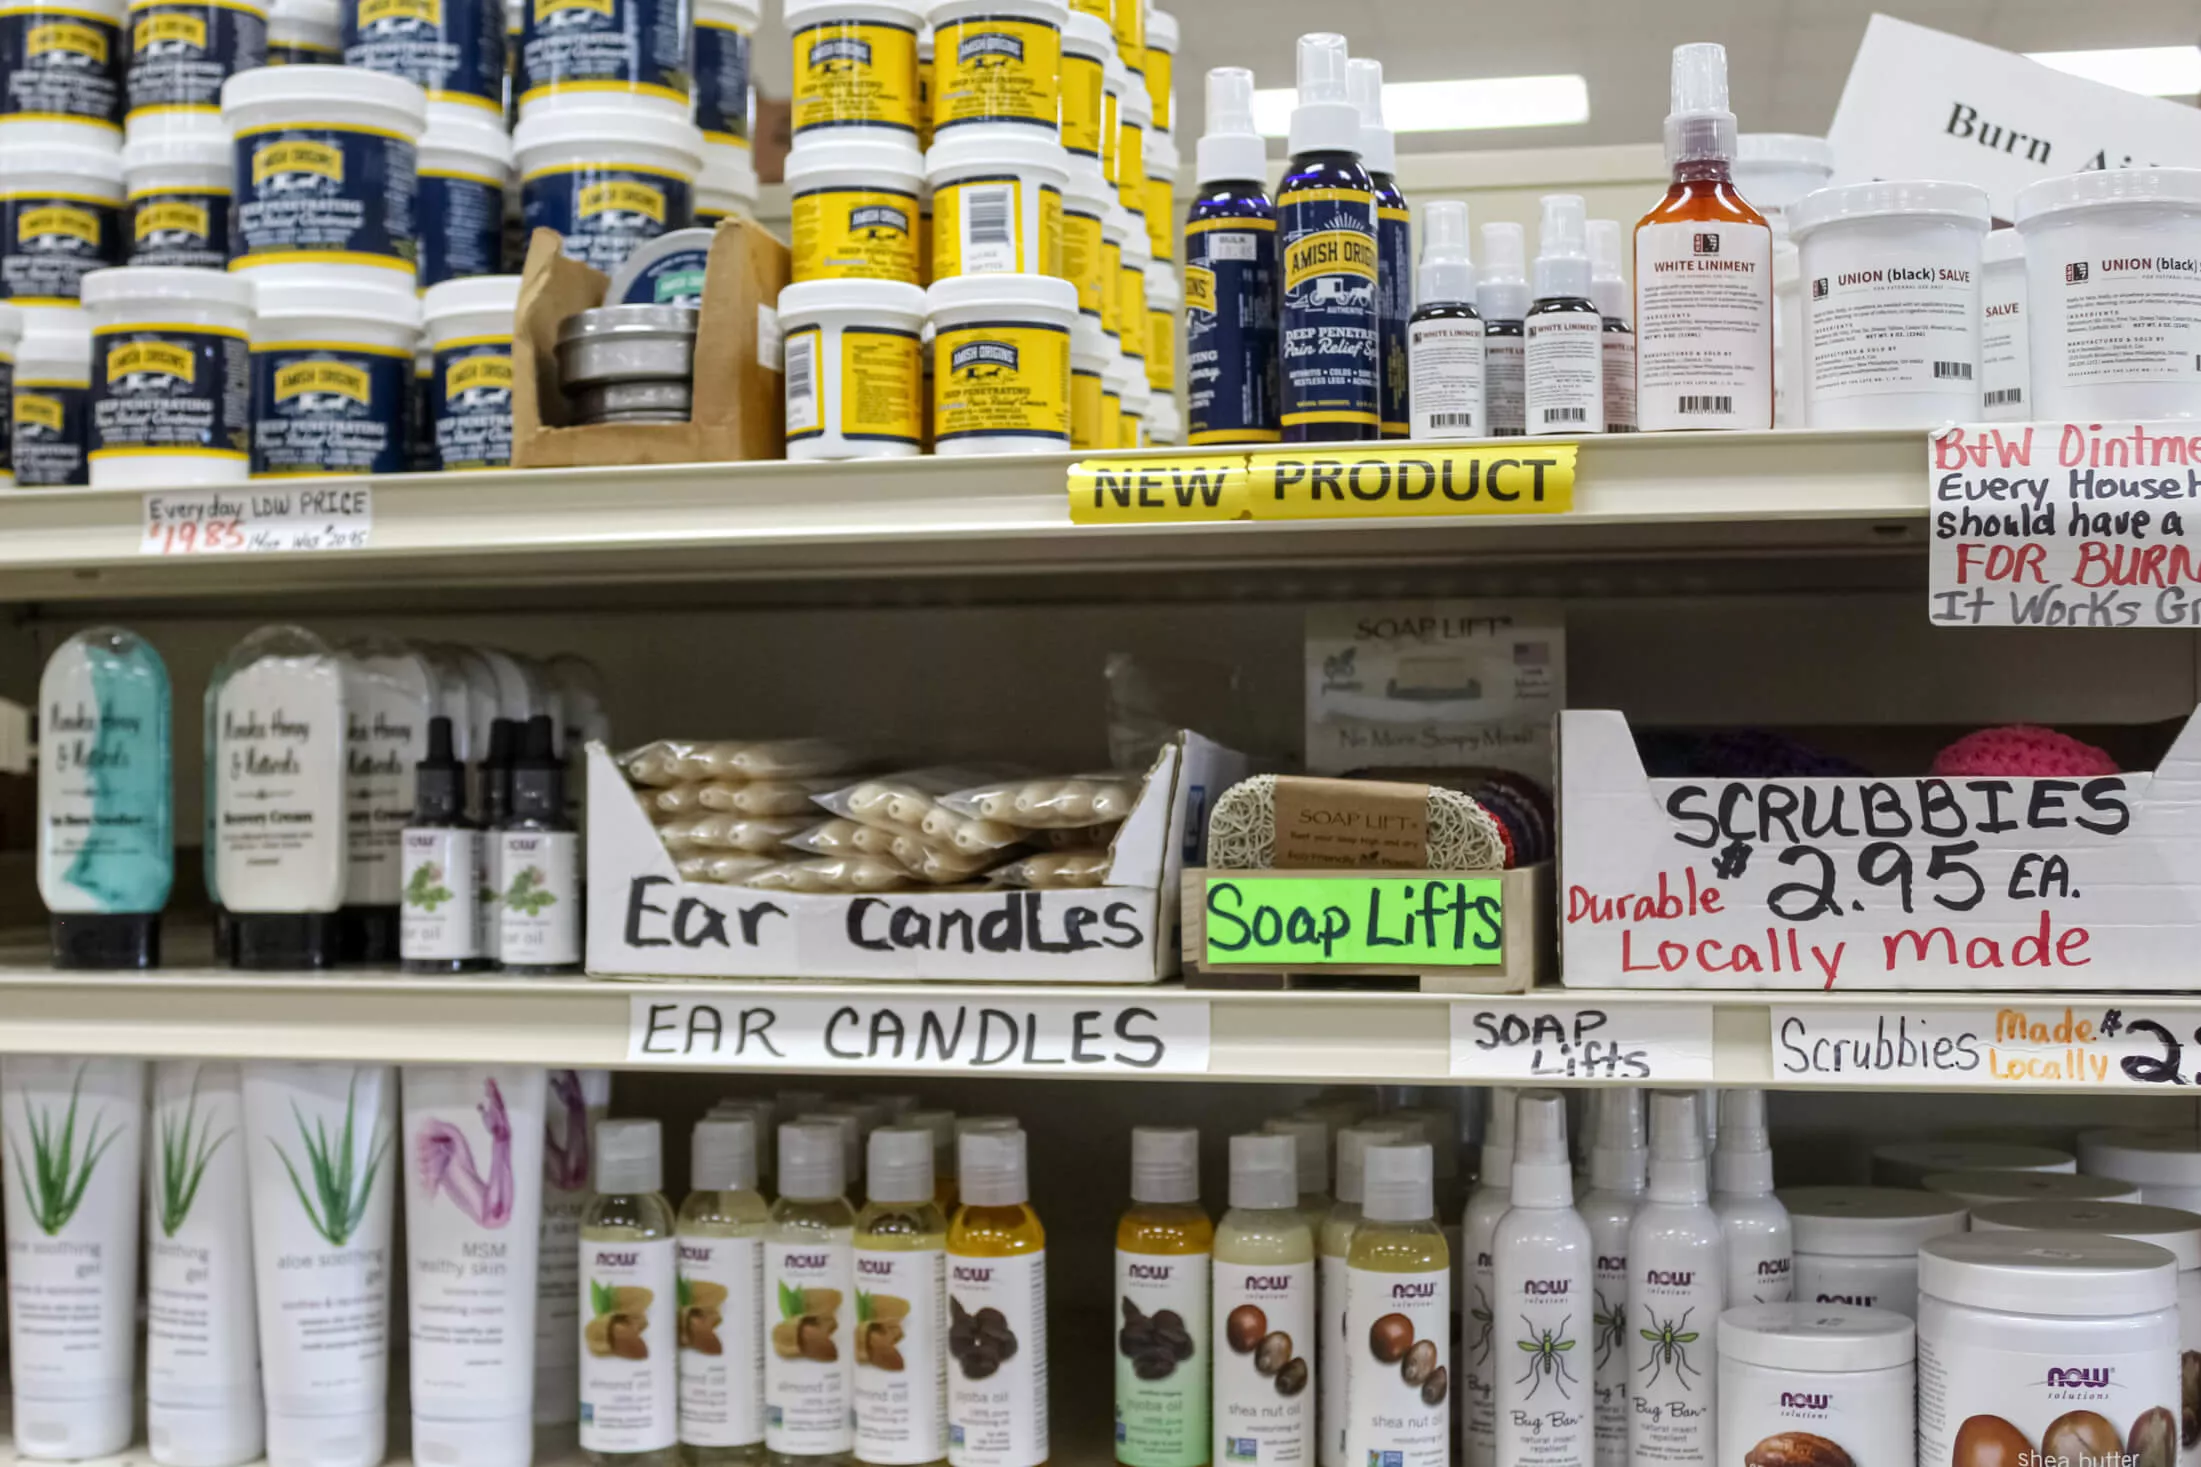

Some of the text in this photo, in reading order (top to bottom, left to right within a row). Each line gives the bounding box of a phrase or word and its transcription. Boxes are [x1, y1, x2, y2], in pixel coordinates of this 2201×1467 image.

[1944, 101, 2053, 165] Burn
[1292, 242, 1338, 275] AMISH
[1654, 260, 1756, 272] WHITE LINIMENT
[2102, 257, 2198, 274] UNION (black)
[1838, 268, 1970, 286] UNION (black) SALVE
[1985, 303, 2019, 318] SALVE
[1285, 327, 1316, 341] DEEP
[1318, 337, 1363, 357] Relief
[1094, 458, 1557, 508] NEW PRODUCT
[1937, 472, 2050, 511] Every
[252, 497, 290, 518] LOW
[300, 490, 368, 515] PRICE
[1936, 501, 2184, 540] should have a
[1956, 543, 2050, 585] FOR
[1932, 586, 1996, 625] It
[2010, 584, 2142, 627] Works
[1354, 616, 1436, 642] SOAP
[1299, 808, 1359, 826] SOAP
[1666, 777, 2131, 848] SCRUBBIES
[1712, 840, 2082, 921] $2.95 EA.
[1567, 867, 1724, 924] Durable
[624, 874, 788, 947] Ear
[1207, 880, 1502, 958] Soap Lifts
[1621, 927, 1846, 991] Locally
[641, 1004, 1165, 1067] EAR CANDLES
[1473, 1010, 1607, 1050] SOAP
[1780, 1016, 1980, 1073] Scrubbies
[1531, 1040, 1651, 1078] Lifts
[1989, 1047, 2108, 1082] Locally
[462, 1241, 507, 1258] MSM
[596, 1252, 637, 1266] now
[785, 1254, 827, 1269] now
[858, 1259, 892, 1275] now
[1758, 1259, 1790, 1276] now
[954, 1267, 990, 1282] now
[1129, 1264, 1170, 1281] now
[1647, 1270, 1692, 1286] now
[1245, 1276, 1289, 1291] now
[1393, 1284, 1435, 1298] now
[1525, 1279, 1568, 1294] now
[2047, 1367, 2109, 1388] now
[1780, 1392, 1829, 1410] now
[2047, 1390, 2110, 1400] solutions
[1229, 1404, 1257, 1417] shea
[1261, 1405, 1283, 1417] nut
[1633, 1397, 1700, 1423] Bug Ban
[1780, 1411, 1828, 1420] solutions
[1372, 1415, 1429, 1428] shea nut
[1510, 1410, 1578, 1435] Bug Ban
[2018, 1449, 2139, 1467] shea butter
